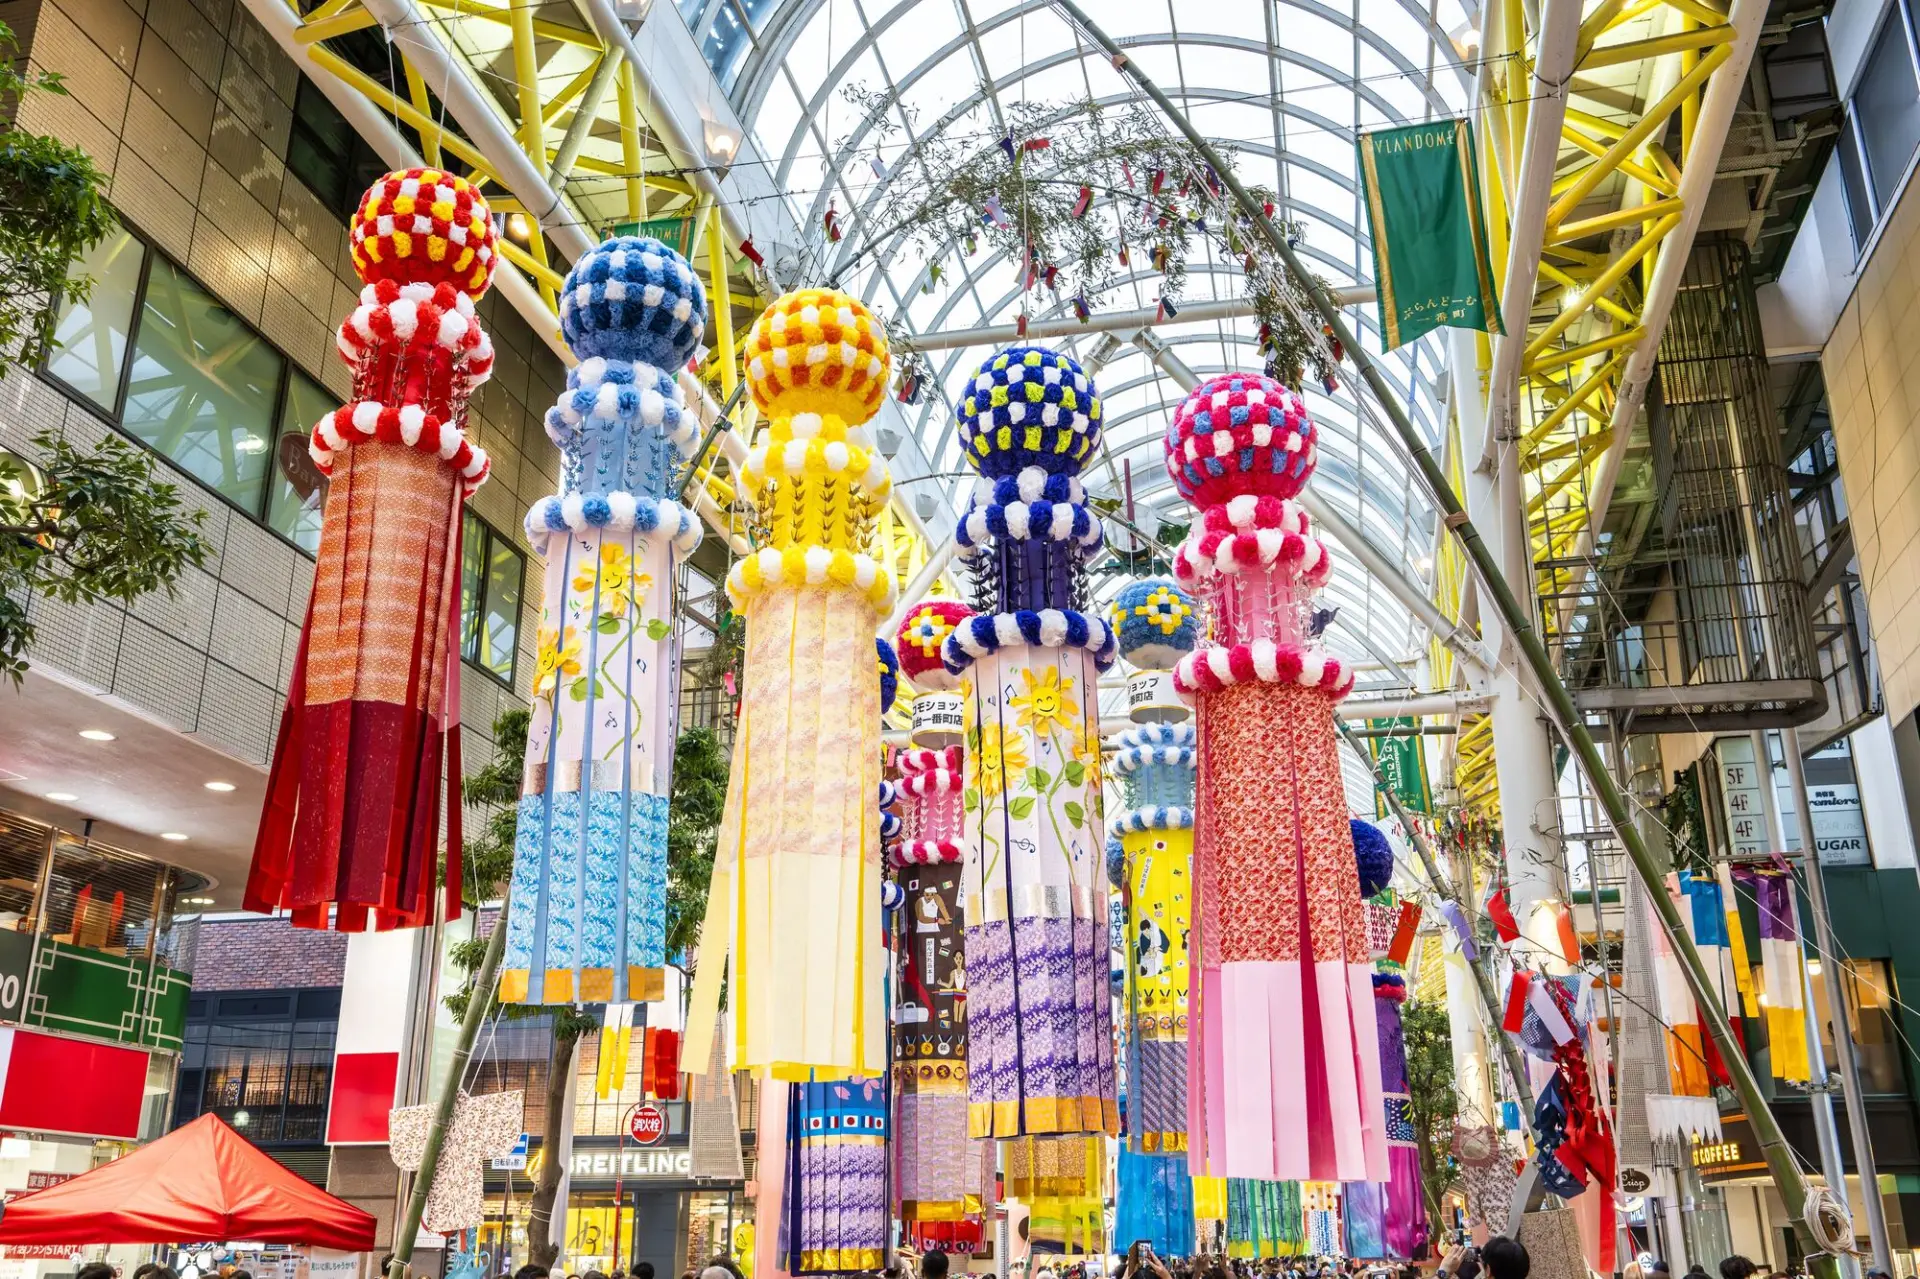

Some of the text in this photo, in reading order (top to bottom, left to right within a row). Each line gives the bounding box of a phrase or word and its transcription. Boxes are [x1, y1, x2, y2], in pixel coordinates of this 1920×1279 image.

[1375, 131, 1455, 154] VLANDOME
[1416, 309, 1465, 323] 一番町
[1128, 677, 1159, 695] ョップ
[1727, 768, 1744, 785] 5F
[1731, 795, 1748, 811] 4F
[1809, 797, 1860, 807] remiere
[1736, 820, 1753, 837] 4F
[633, 1118, 661, 1132] 消火栓
[1700, 1143, 1740, 1165] COFFEE
